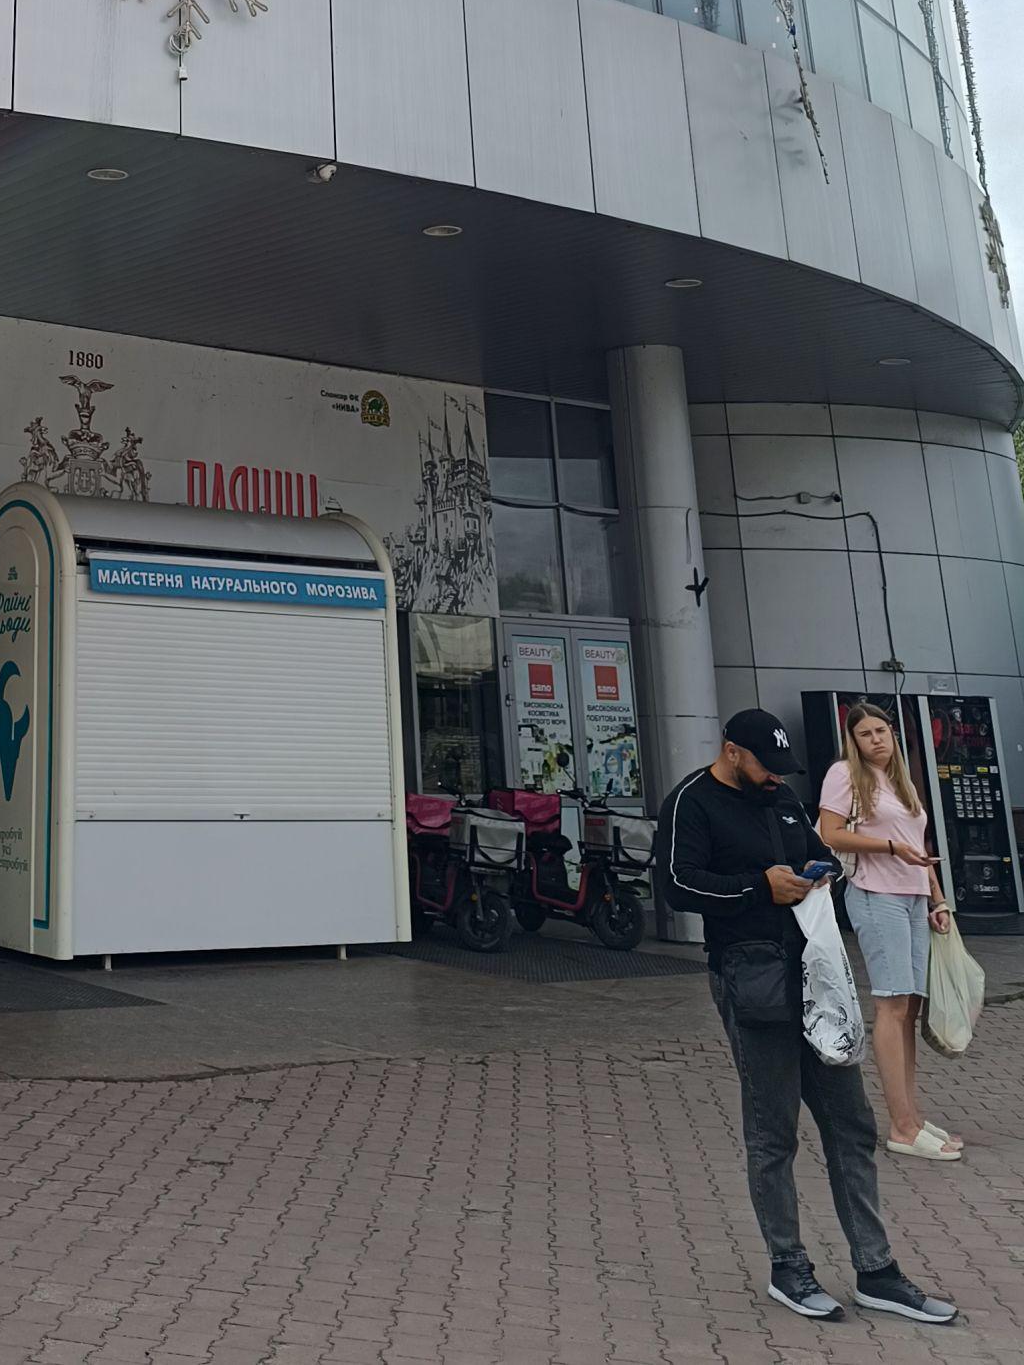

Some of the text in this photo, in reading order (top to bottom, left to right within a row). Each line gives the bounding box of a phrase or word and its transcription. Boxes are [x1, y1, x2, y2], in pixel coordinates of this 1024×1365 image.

[69, 350, 103, 369] 1880
[97, 568, 378, 601] МАЙСТЕРНЯ НАТУРАЛЬНОГО МОРОЗИВА
[519, 646, 552, 657] BEAUTY
[585, 649, 616, 659] BEAUTY
[531, 683, 552, 692] sano
[597, 685, 617, 694] sano
